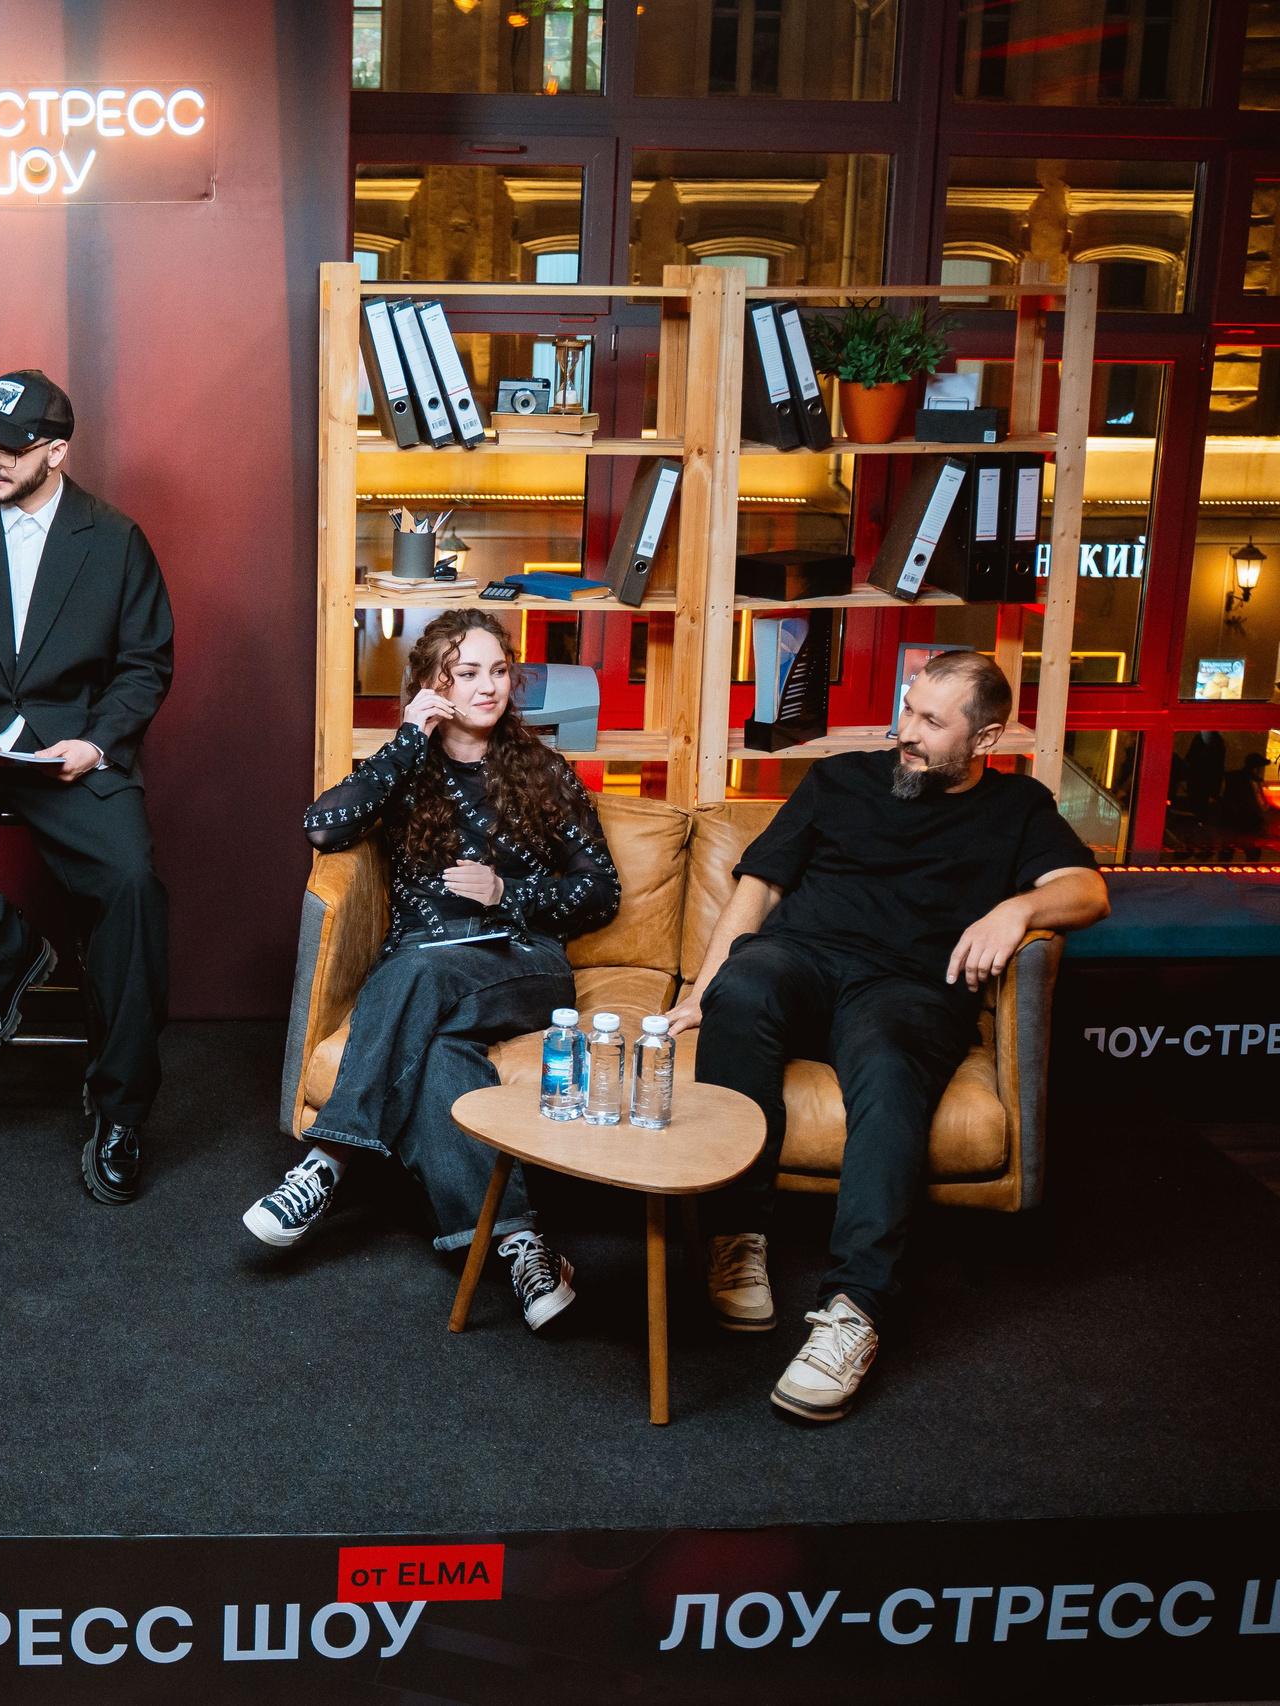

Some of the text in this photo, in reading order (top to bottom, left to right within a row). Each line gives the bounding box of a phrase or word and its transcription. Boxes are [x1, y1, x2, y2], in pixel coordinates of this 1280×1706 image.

[398, 1561, 491, 1586] ELMA
[222, 1600, 428, 1662] ШОУ
[659, 1580, 1216, 1651] ЛОУ-СТРЕСС
